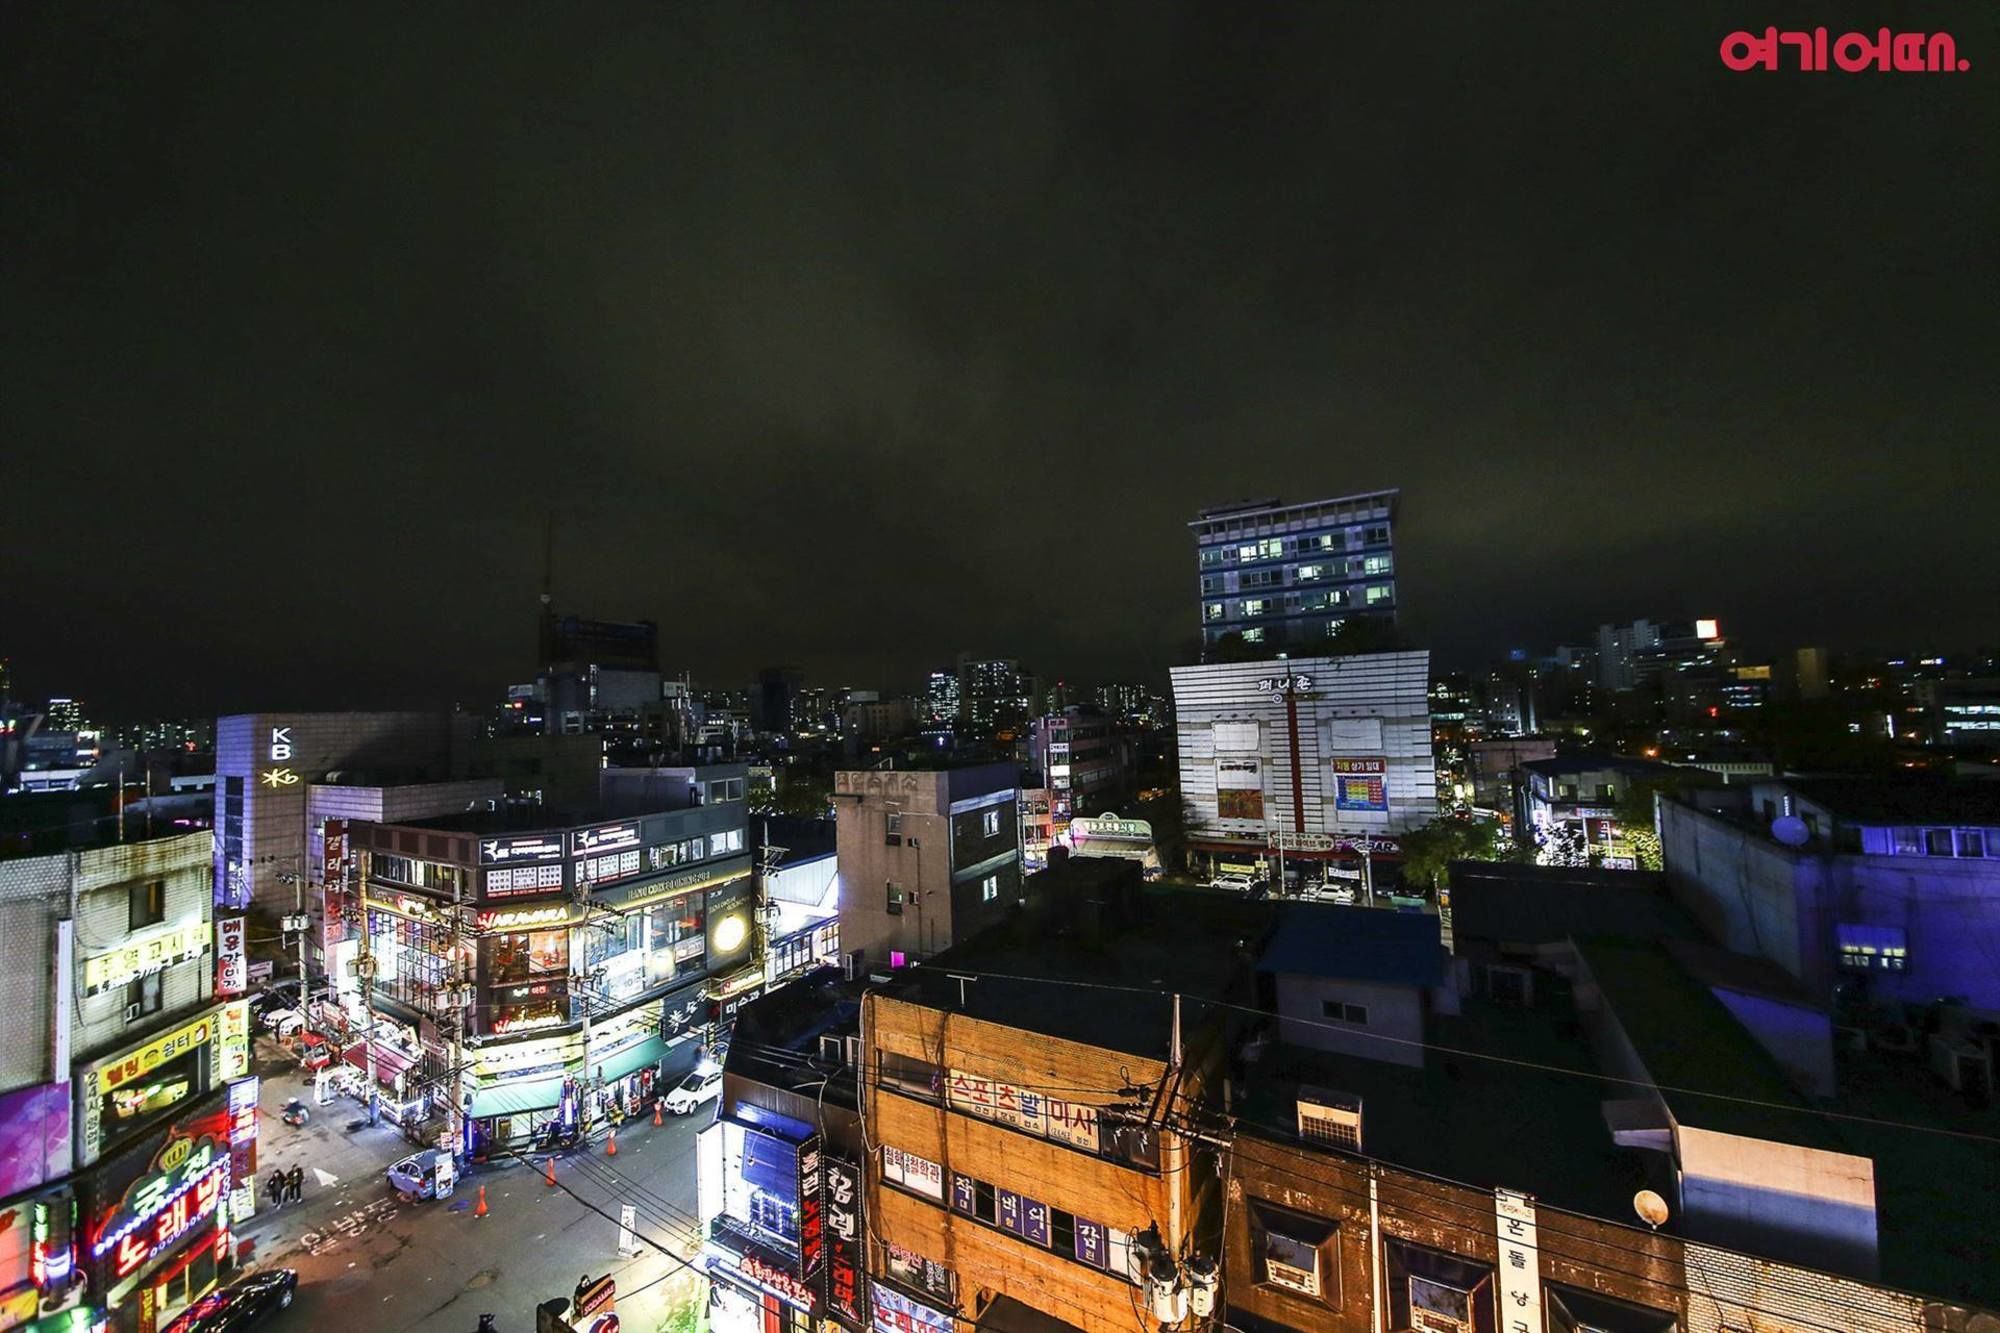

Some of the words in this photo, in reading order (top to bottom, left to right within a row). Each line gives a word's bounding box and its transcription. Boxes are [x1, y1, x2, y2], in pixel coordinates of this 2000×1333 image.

[272, 727, 292, 761] KB
[954, 1074, 1017, 1112] 스포츠
[1020, 1090, 1040, 1119] 발
